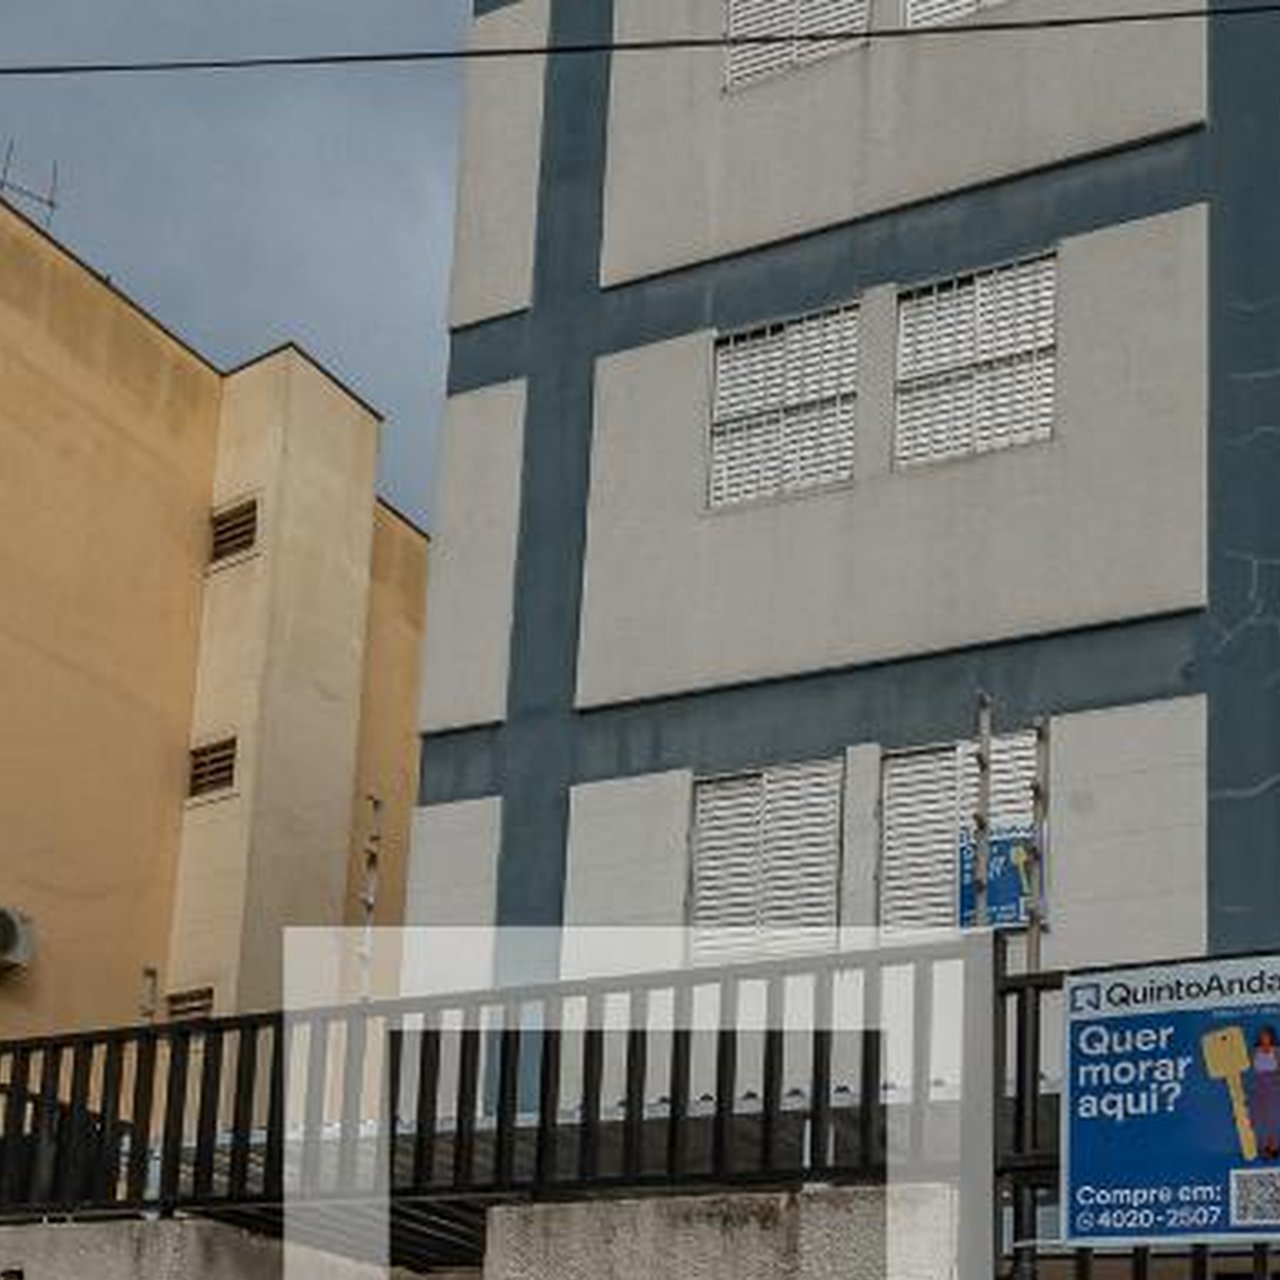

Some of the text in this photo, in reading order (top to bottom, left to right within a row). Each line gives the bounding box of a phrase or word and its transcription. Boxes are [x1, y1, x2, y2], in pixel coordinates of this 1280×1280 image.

[1079, 1025, 1173, 1054] Quer
[1078, 1056, 1192, 1086] morar
[1078, 1082, 1181, 1120] aqui?
[1076, 1185, 1170, 1206] Compre
